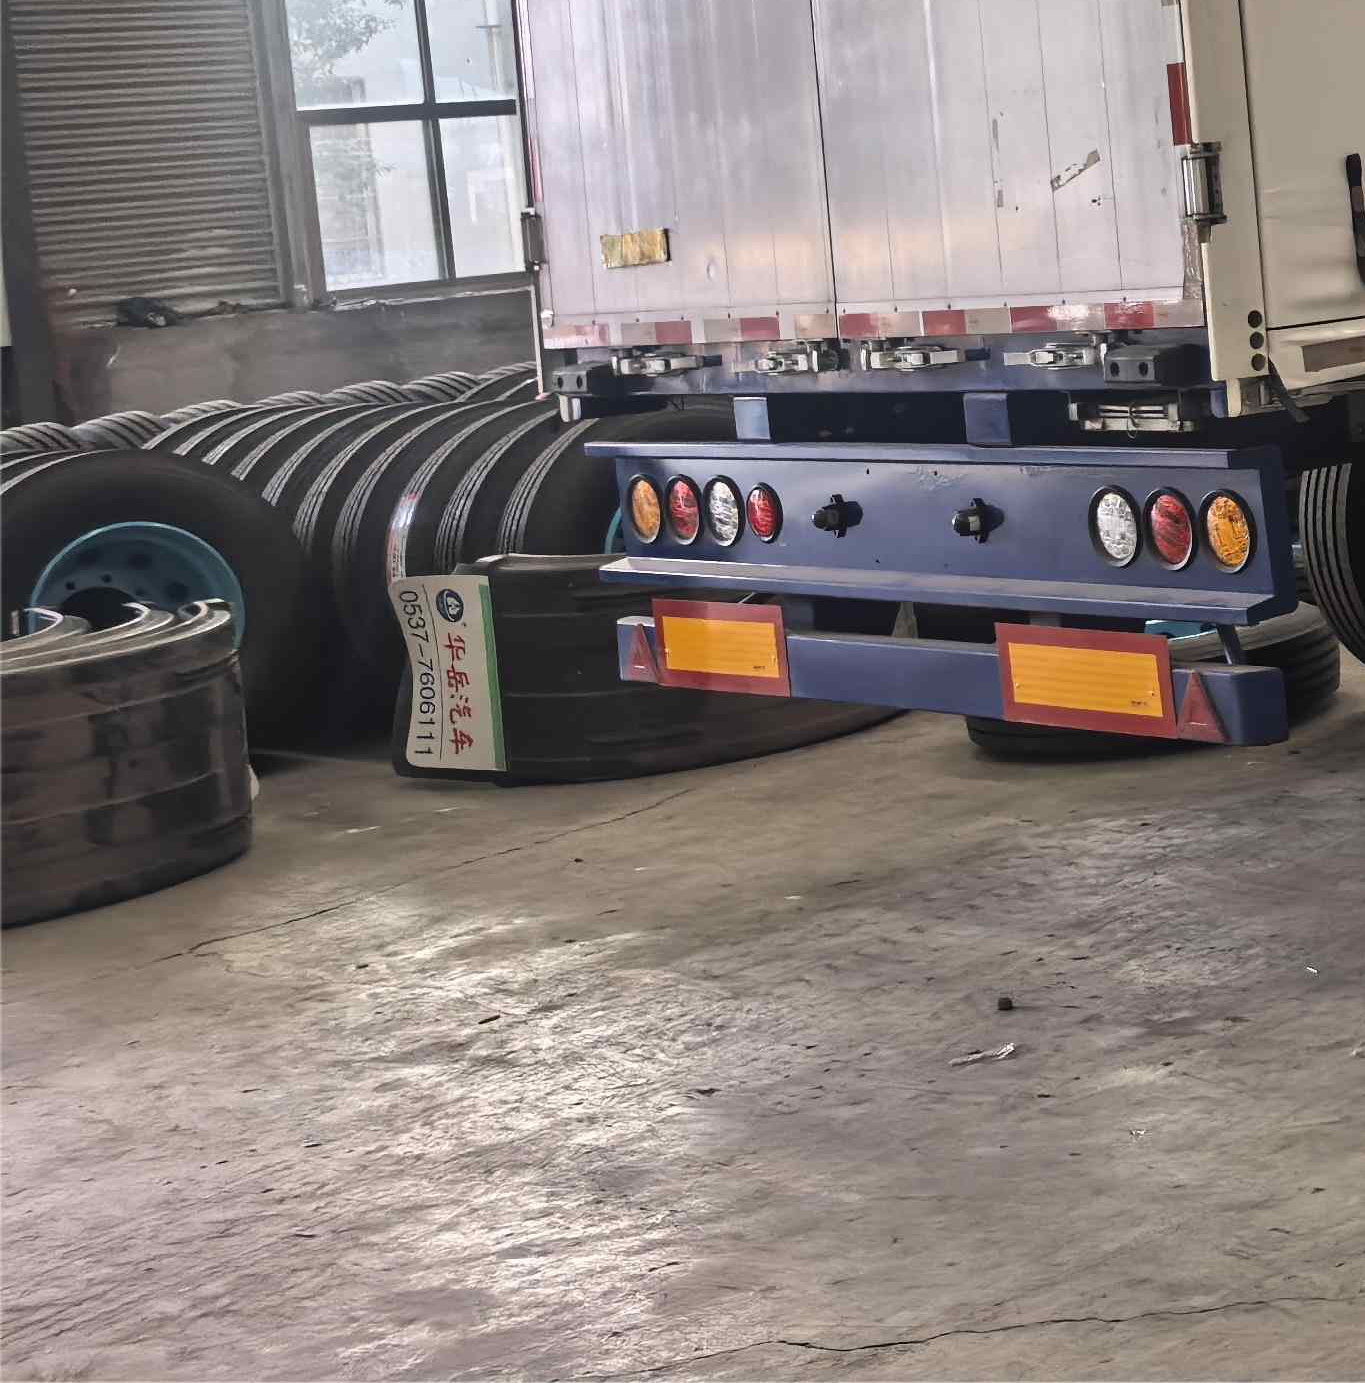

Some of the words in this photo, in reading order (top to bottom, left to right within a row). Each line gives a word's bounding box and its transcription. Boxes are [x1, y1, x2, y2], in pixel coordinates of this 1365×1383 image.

[399, 589, 436, 756] 0537-7606111
[440, 632, 474, 755] 华岳汽车
